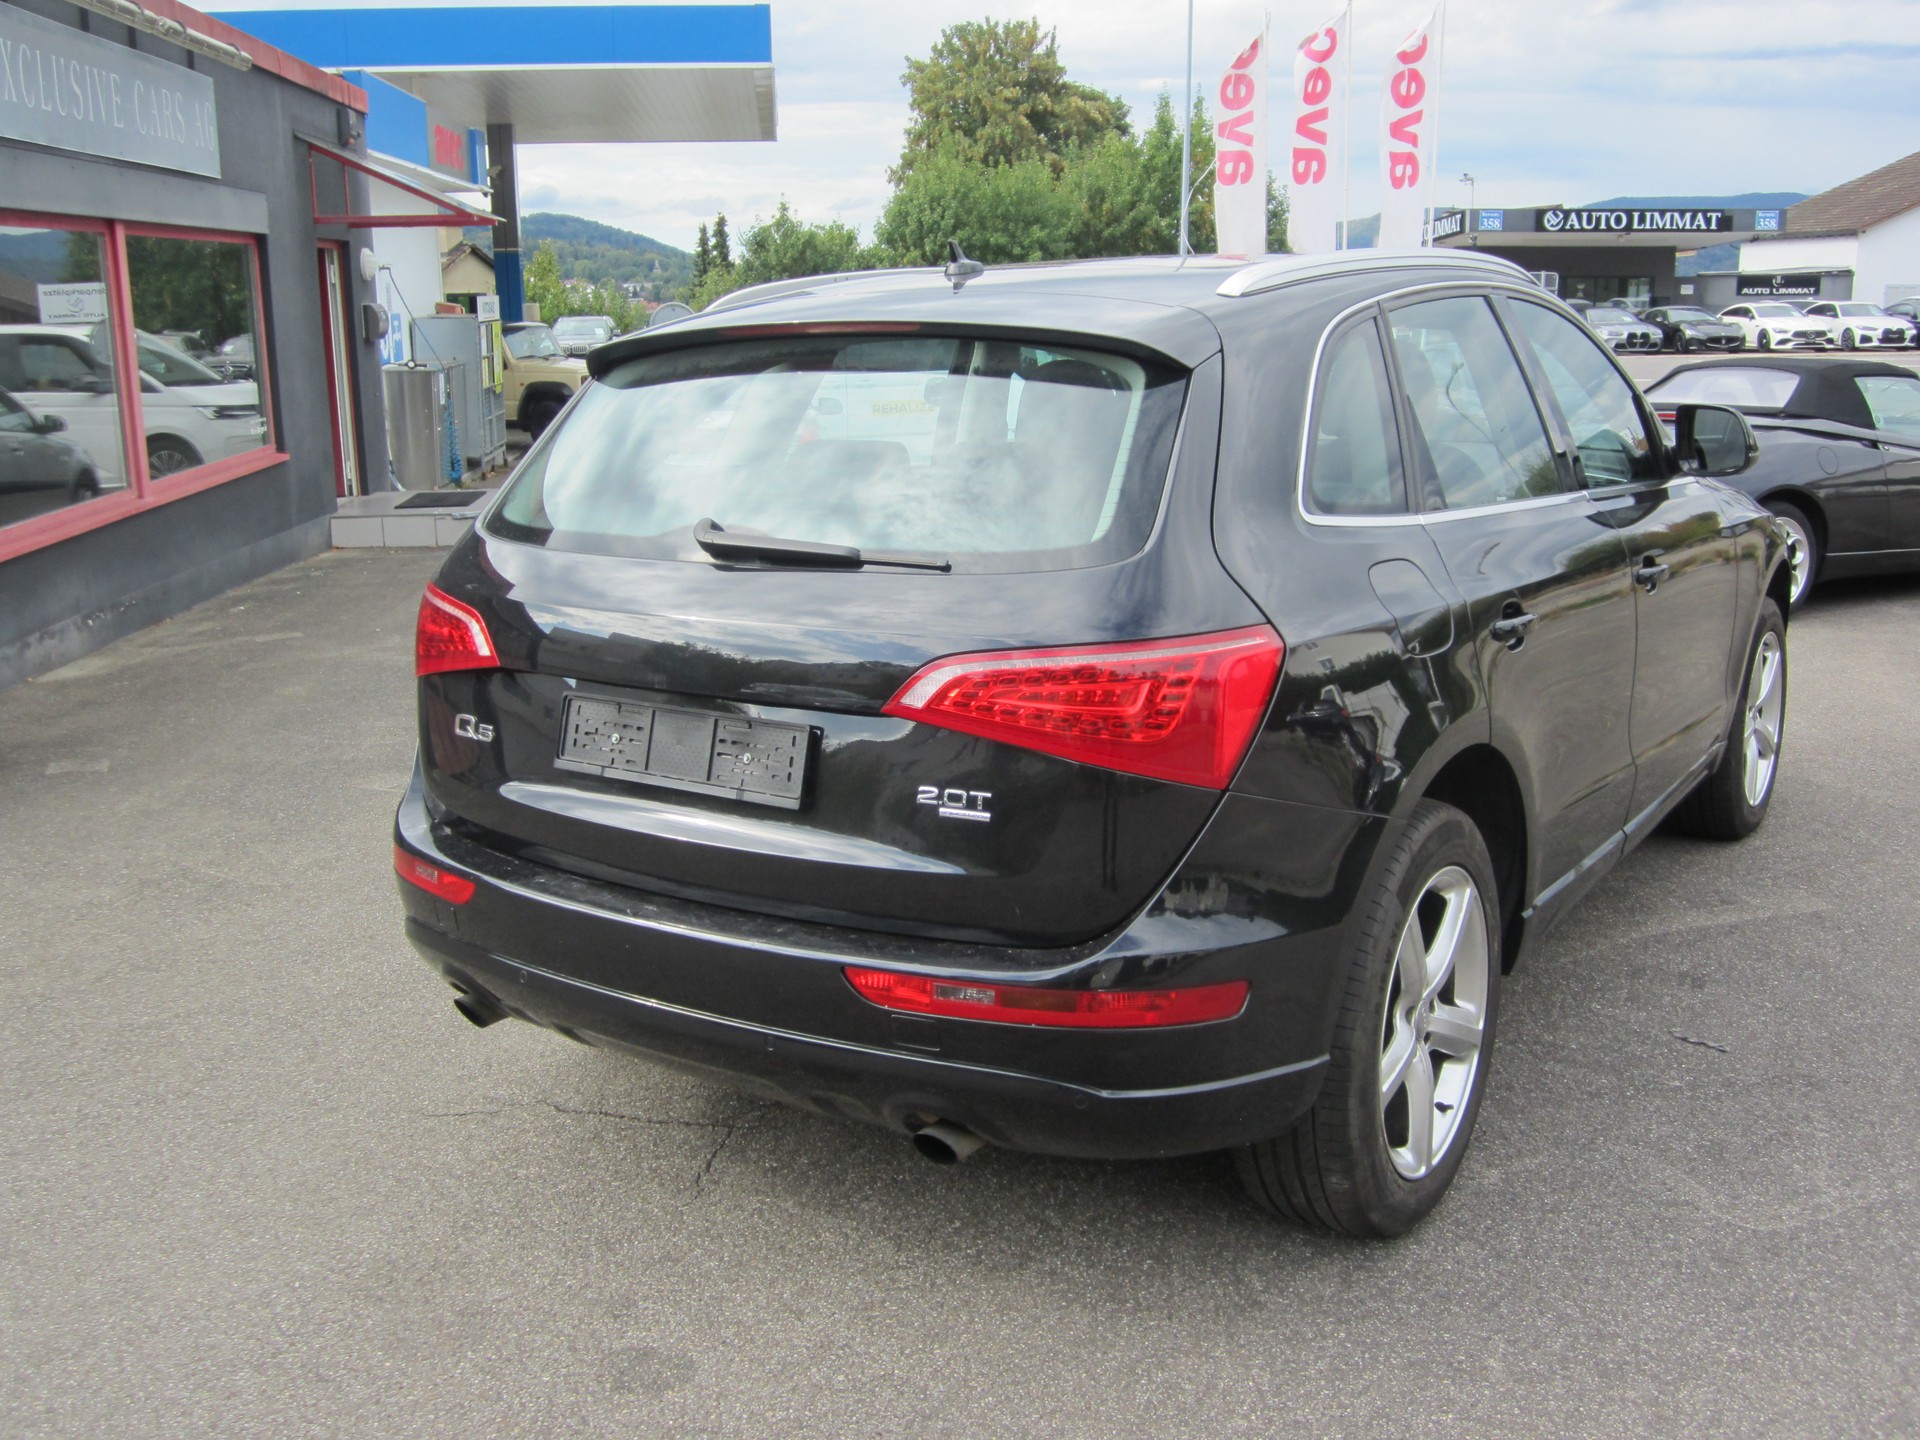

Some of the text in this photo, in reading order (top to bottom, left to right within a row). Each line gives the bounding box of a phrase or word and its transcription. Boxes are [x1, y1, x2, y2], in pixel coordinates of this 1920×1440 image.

[134, 80, 186, 144] CARS
[195, 101, 214, 151] AG
[1432, 213, 1462, 238] IMMAT
[1481, 218, 1500, 229] 358
[1565, 211, 1722, 230] AUTO LIMMAT
[1758, 218, 1776, 229] 358
[1741, 287, 1816, 295] AUTO LIMMAT
[455, 713, 495, 743] Q5
[916, 786, 992, 810] 2.0T
